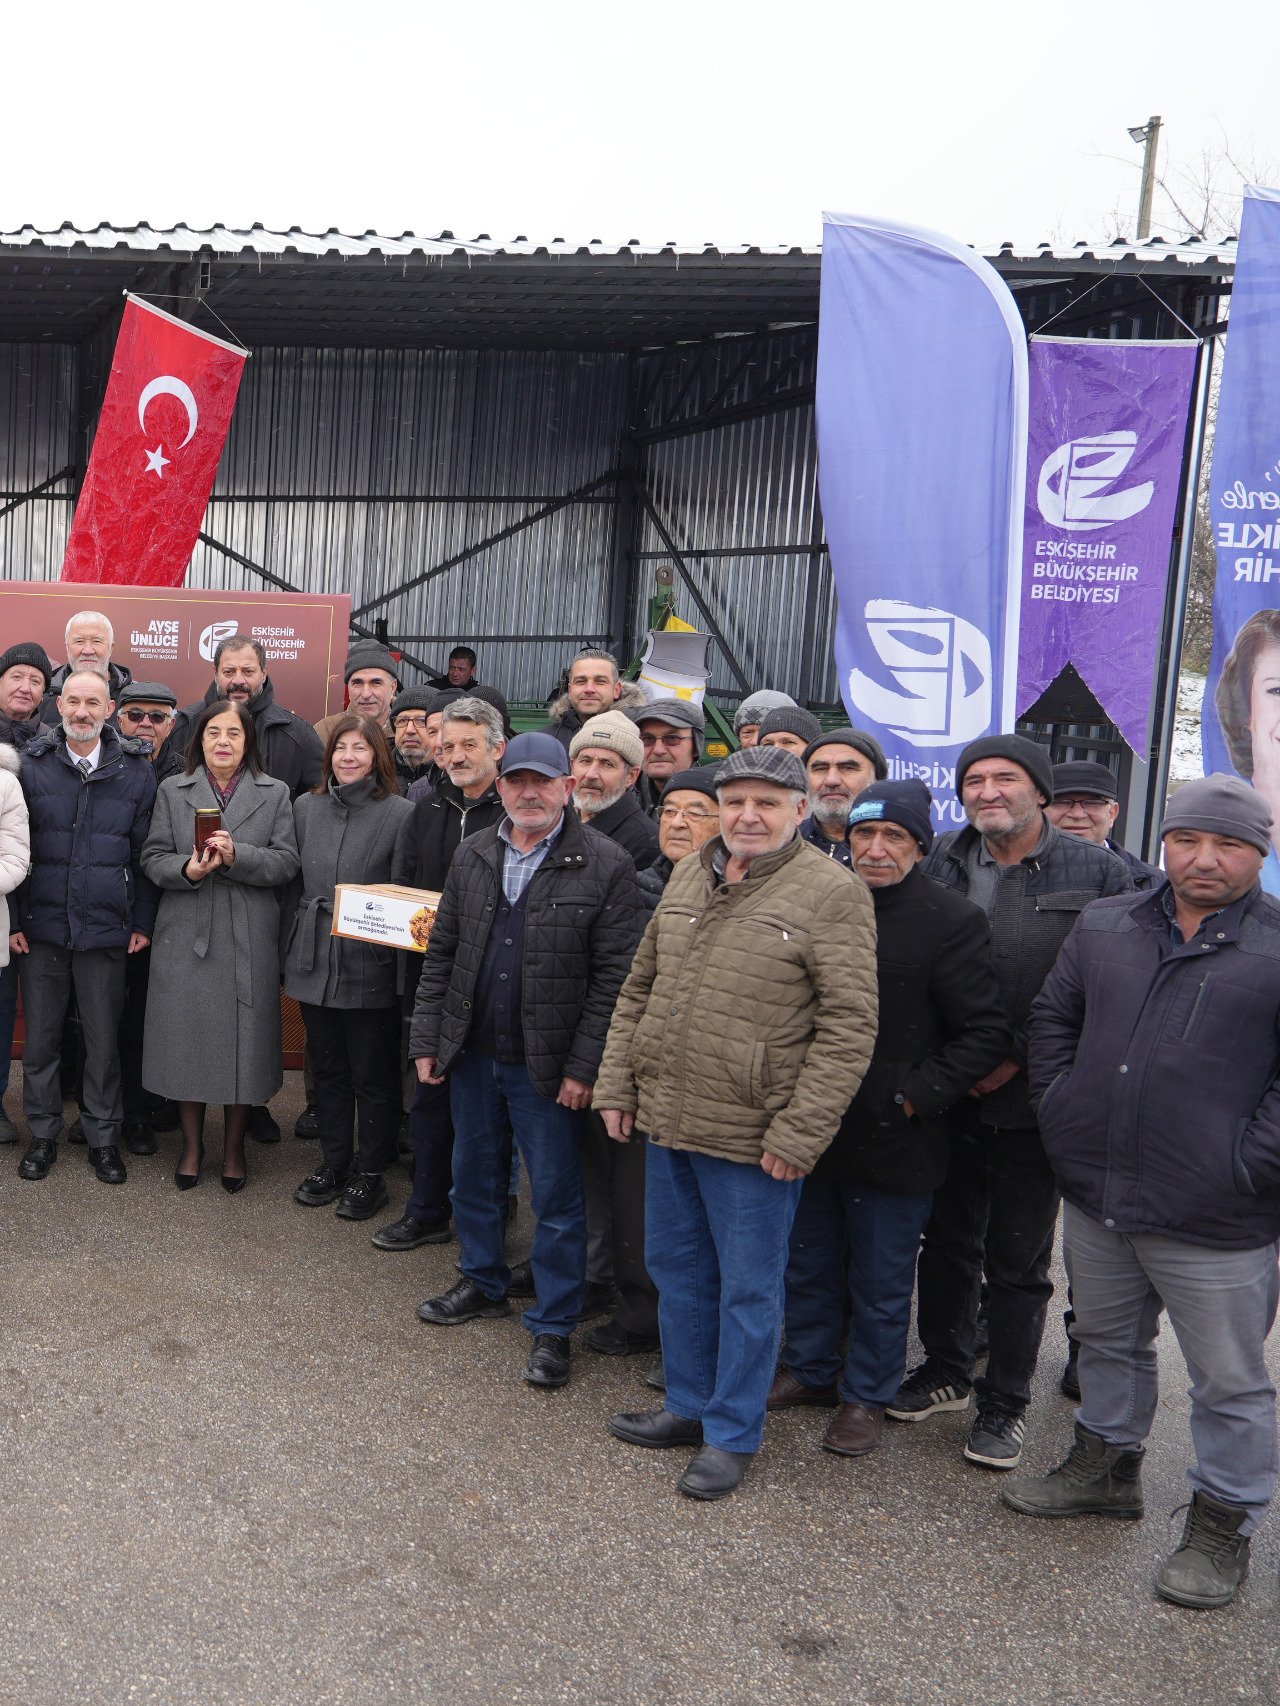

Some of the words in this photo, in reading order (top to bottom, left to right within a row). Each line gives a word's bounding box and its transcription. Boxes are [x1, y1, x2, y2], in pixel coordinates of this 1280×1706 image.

[1035, 539, 1117, 560] ESKİŞEHİR
[1033, 559, 1139, 583] BÜYÜKŞEHİR
[1031, 583, 1120, 603] BELEDİYESİ
[148, 620, 180, 635] AYŞE
[252, 625, 295, 637] ESKİŞEHİR
[131, 630, 179, 647] ÜNLÜCE
[252, 637, 306, 649] ÜYÜKŞEHİR
[265, 649, 298, 660] EDİYESİ
